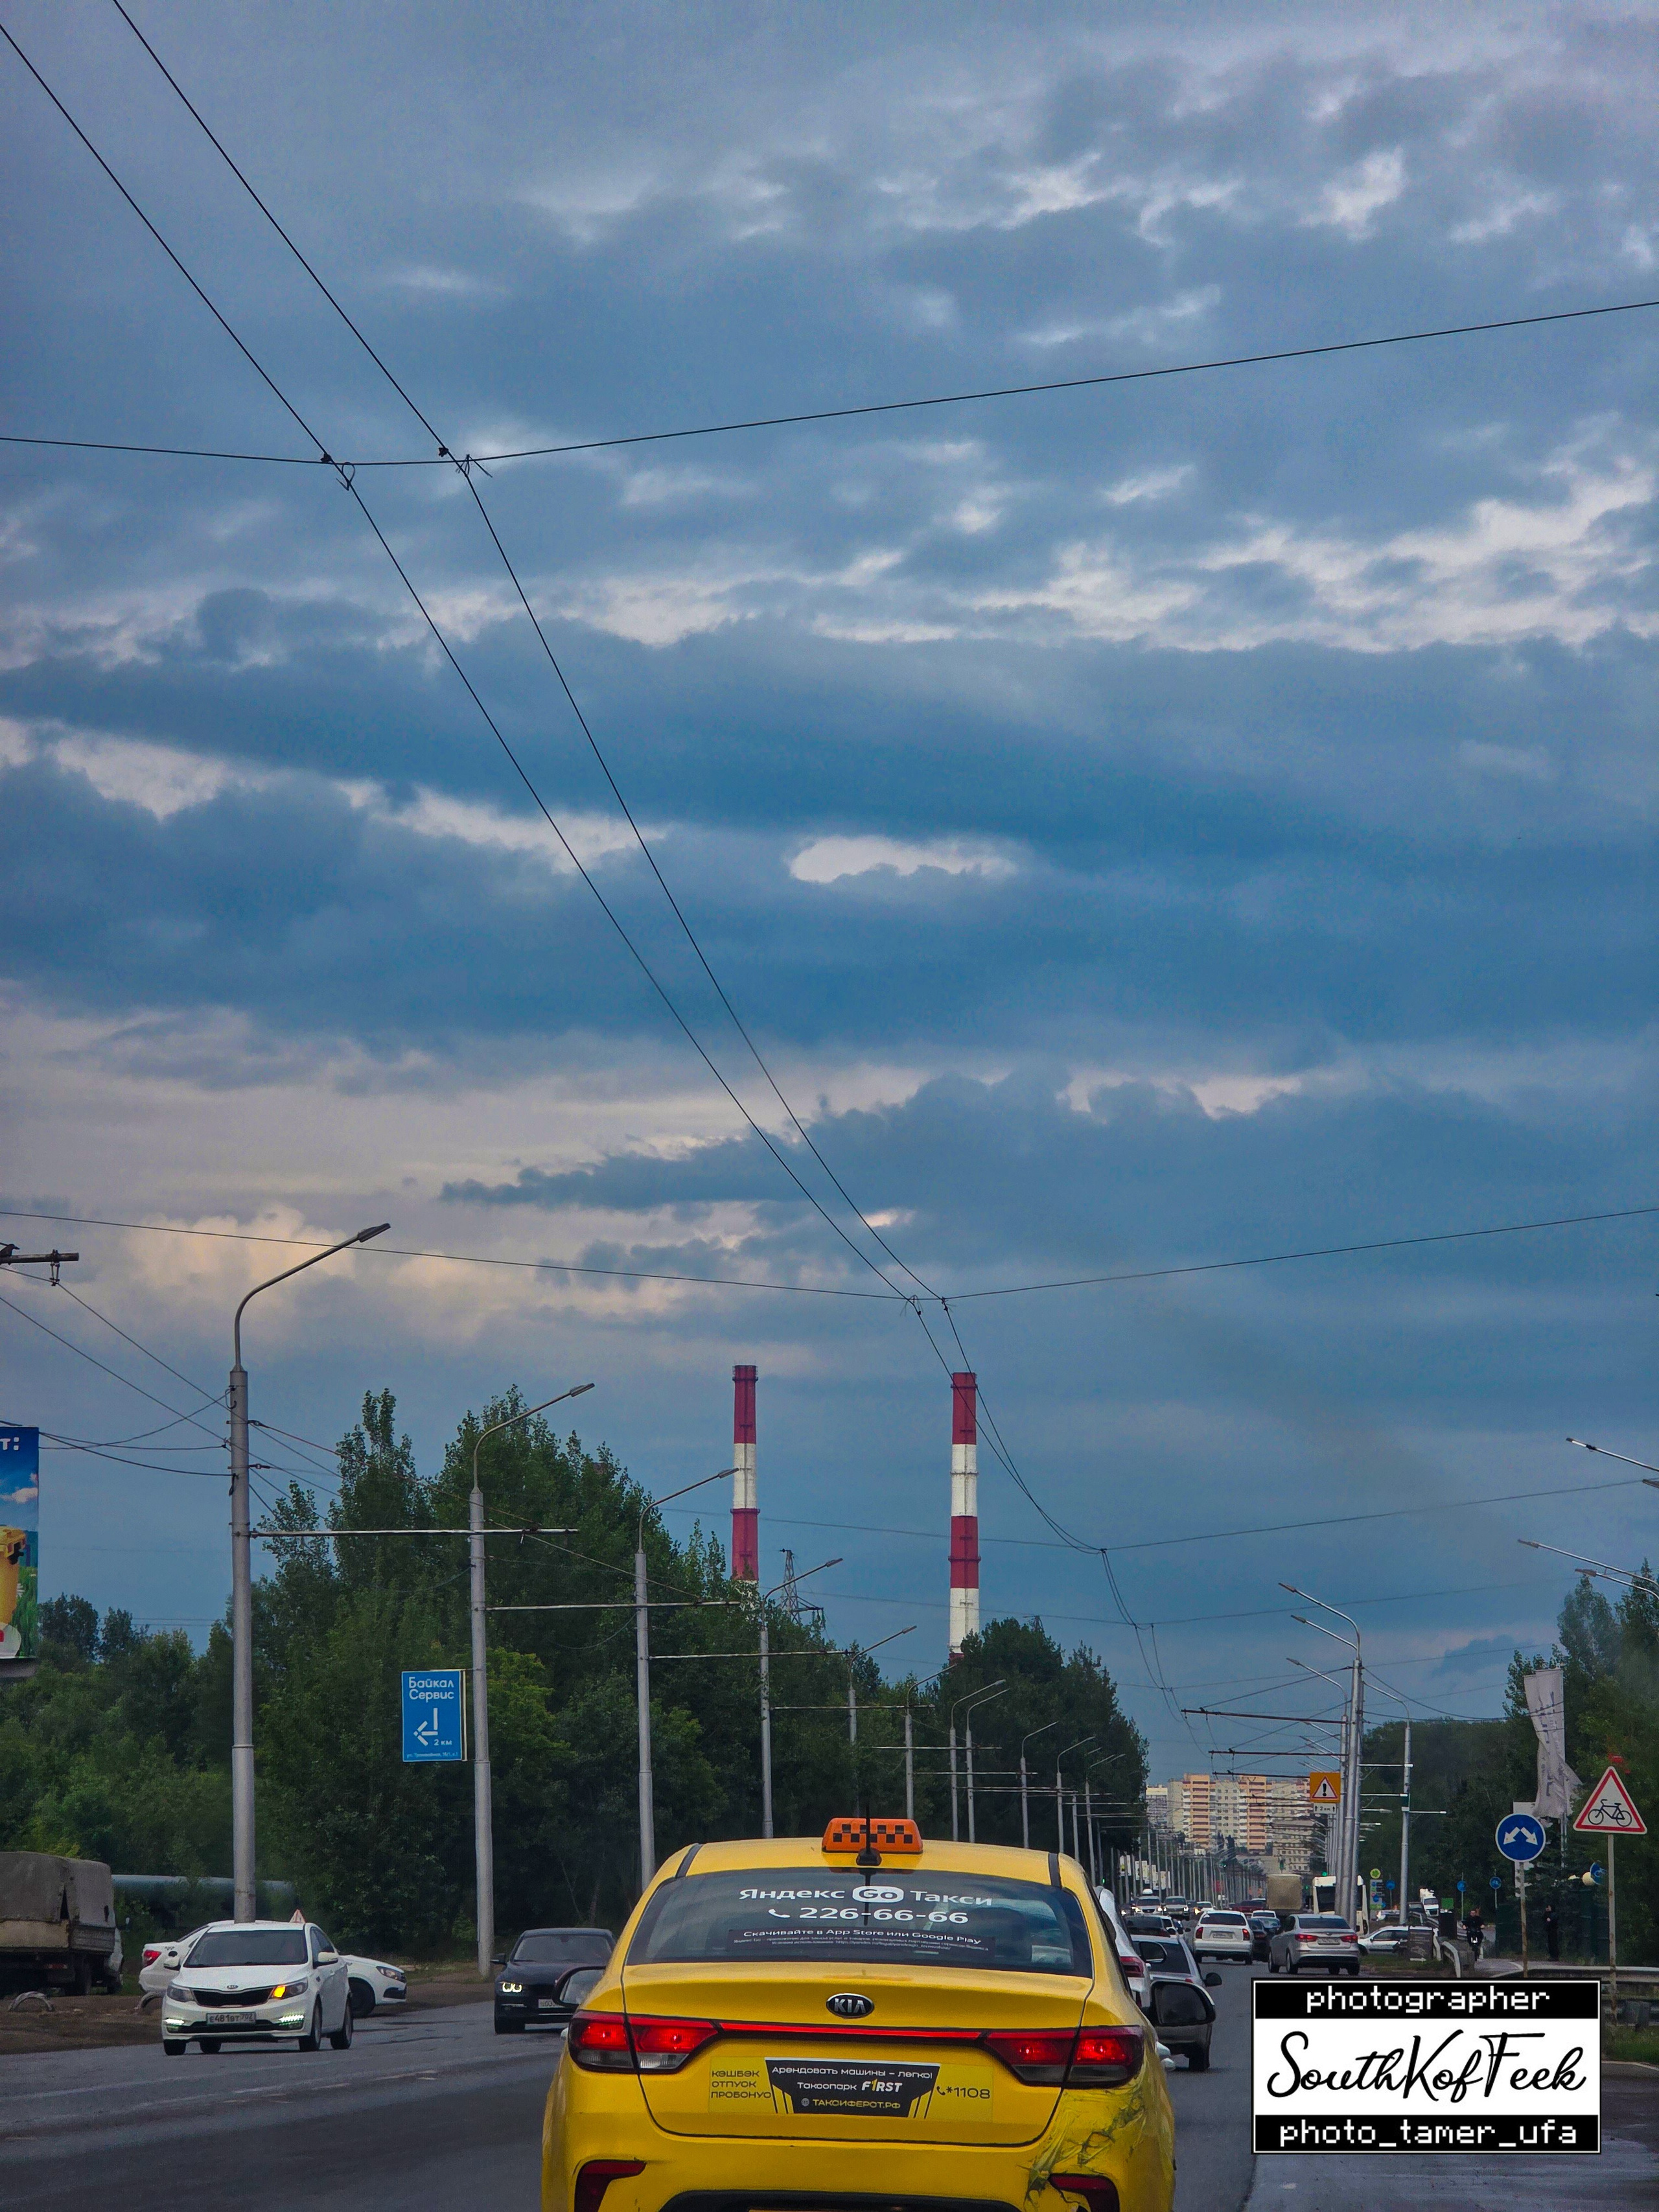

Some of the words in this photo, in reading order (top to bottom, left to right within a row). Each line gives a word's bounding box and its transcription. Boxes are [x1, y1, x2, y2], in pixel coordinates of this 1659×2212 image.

[408, 1677, 454, 1688] Байкал
[409, 1688, 454, 1703] Сервис
[739, 1889, 846, 1900] Яндекс
[857, 1888, 899, 1900] Go
[910, 1890, 992, 1906] Такси
[799, 1907, 968, 1924] 226-66-66
[957, 1936, 981, 1944] Play
[834, 1998, 866, 2013] KIA
[772, 2066, 838, 2075] Арендовать
[898, 2071, 933, 2079] легко!
